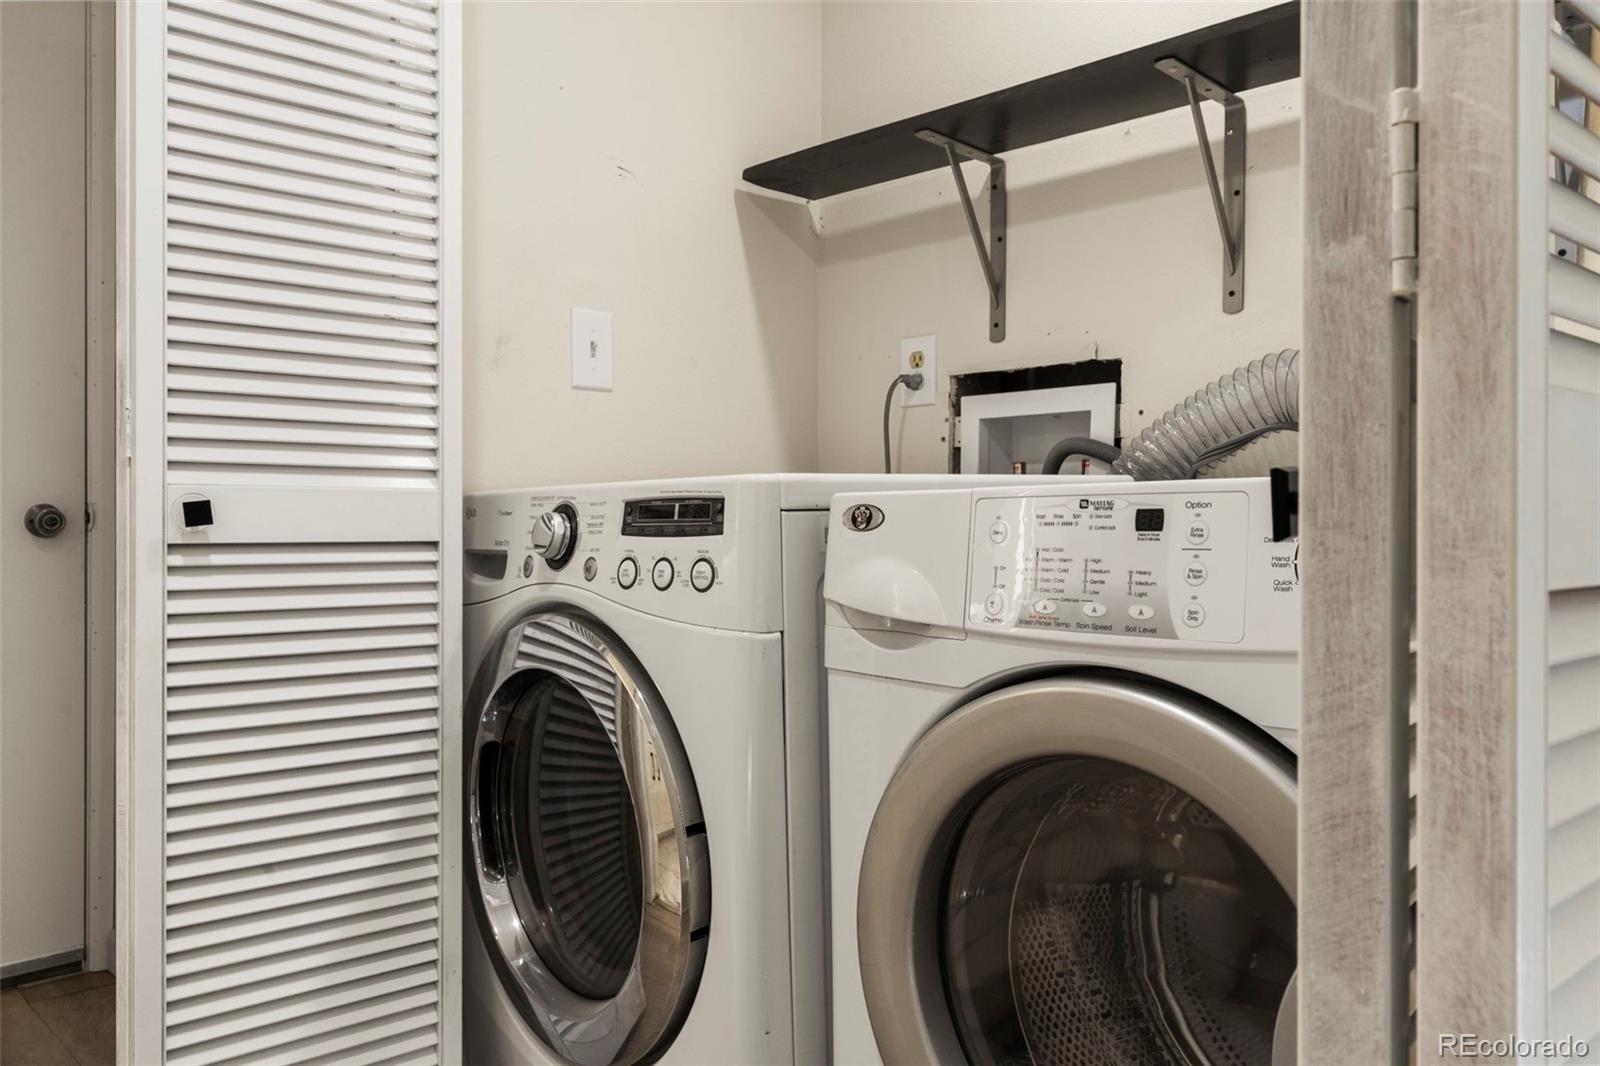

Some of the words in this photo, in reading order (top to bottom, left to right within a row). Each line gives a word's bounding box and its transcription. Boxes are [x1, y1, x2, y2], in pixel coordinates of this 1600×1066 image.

[1185, 501, 1213, 510] Option
[1018, 618, 1052, 626] Wash/Rinse
[1053, 621, 1071, 629] Temp
[1187, 615, 1199, 623] Only
[1091, 623, 1113, 631] Speed
[1124, 625, 1137, 633] Soil
[1138, 626, 1157, 634] Level
